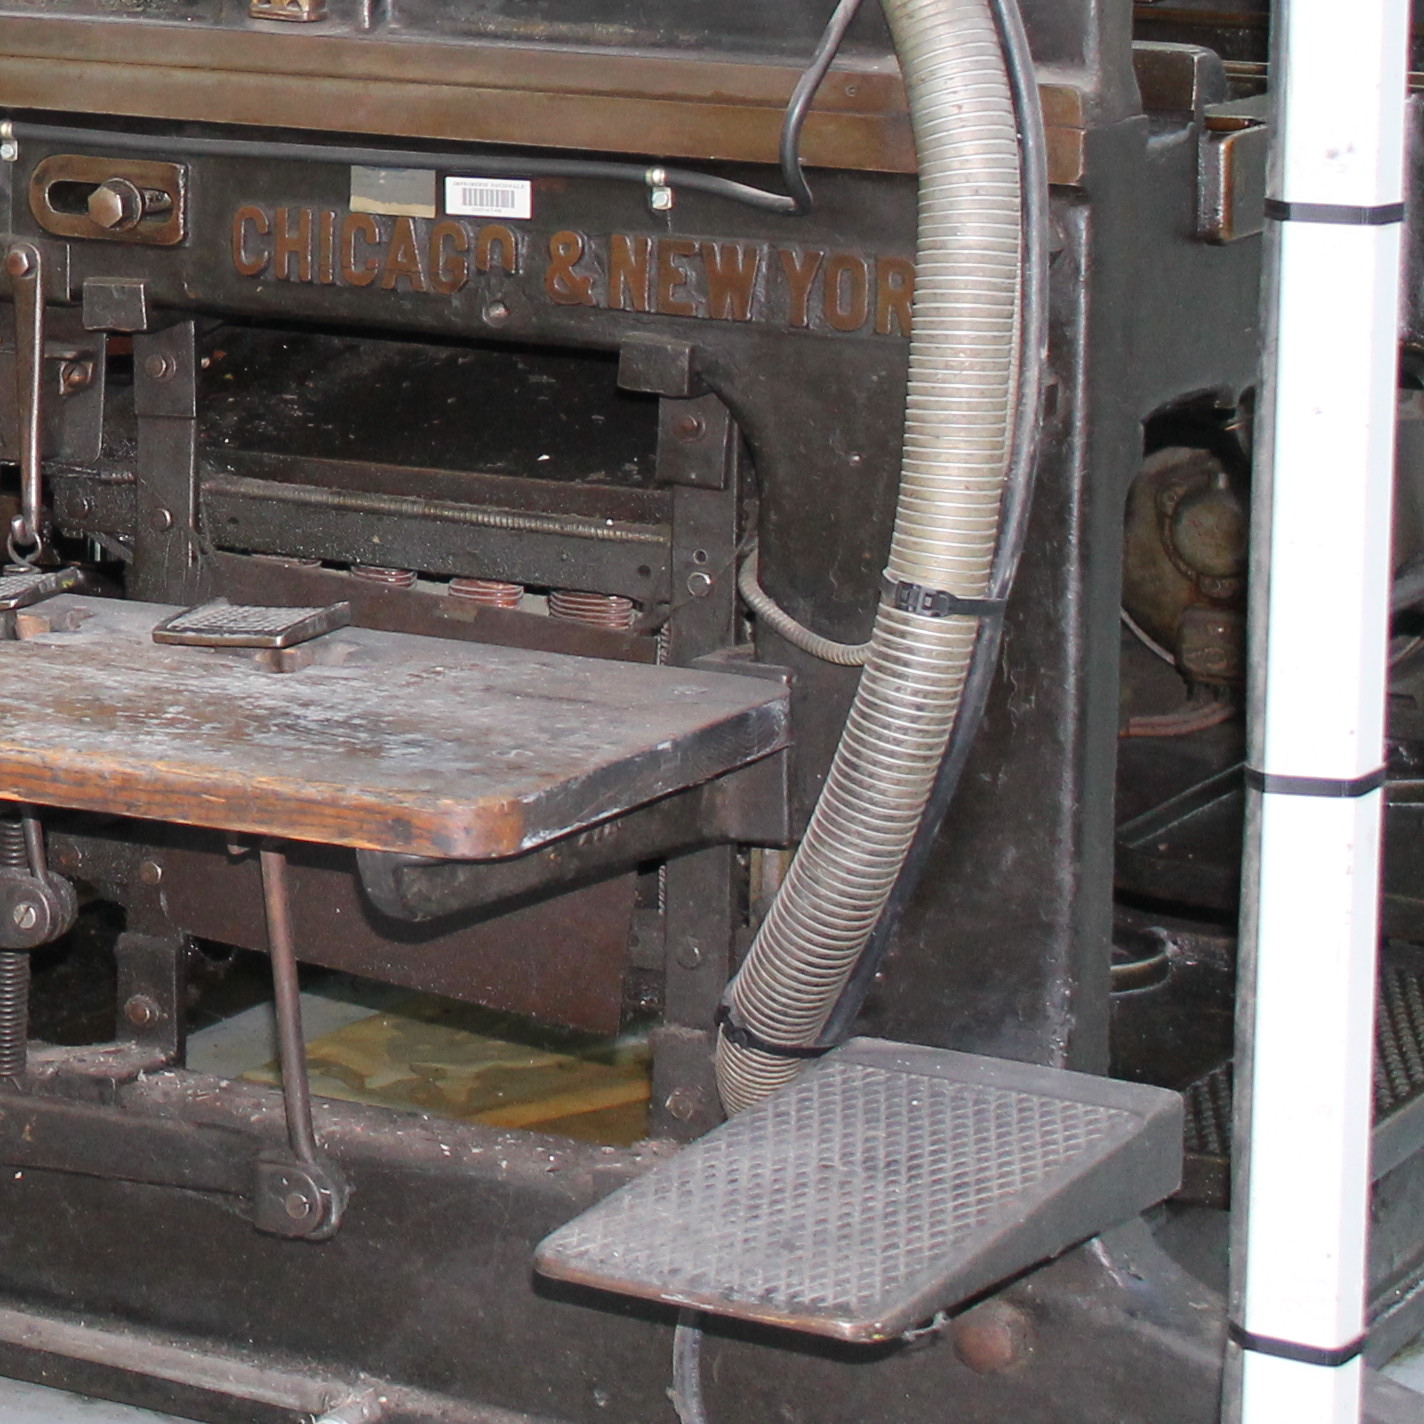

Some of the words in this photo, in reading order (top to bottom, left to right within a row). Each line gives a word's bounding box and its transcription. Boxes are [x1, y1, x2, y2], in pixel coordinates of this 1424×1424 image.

[231, 206, 522, 295] CHICAGO
[546, 230, 592, 306] &
[608, 233, 759, 322] NEW
[774, 247, 914, 337] YOR
